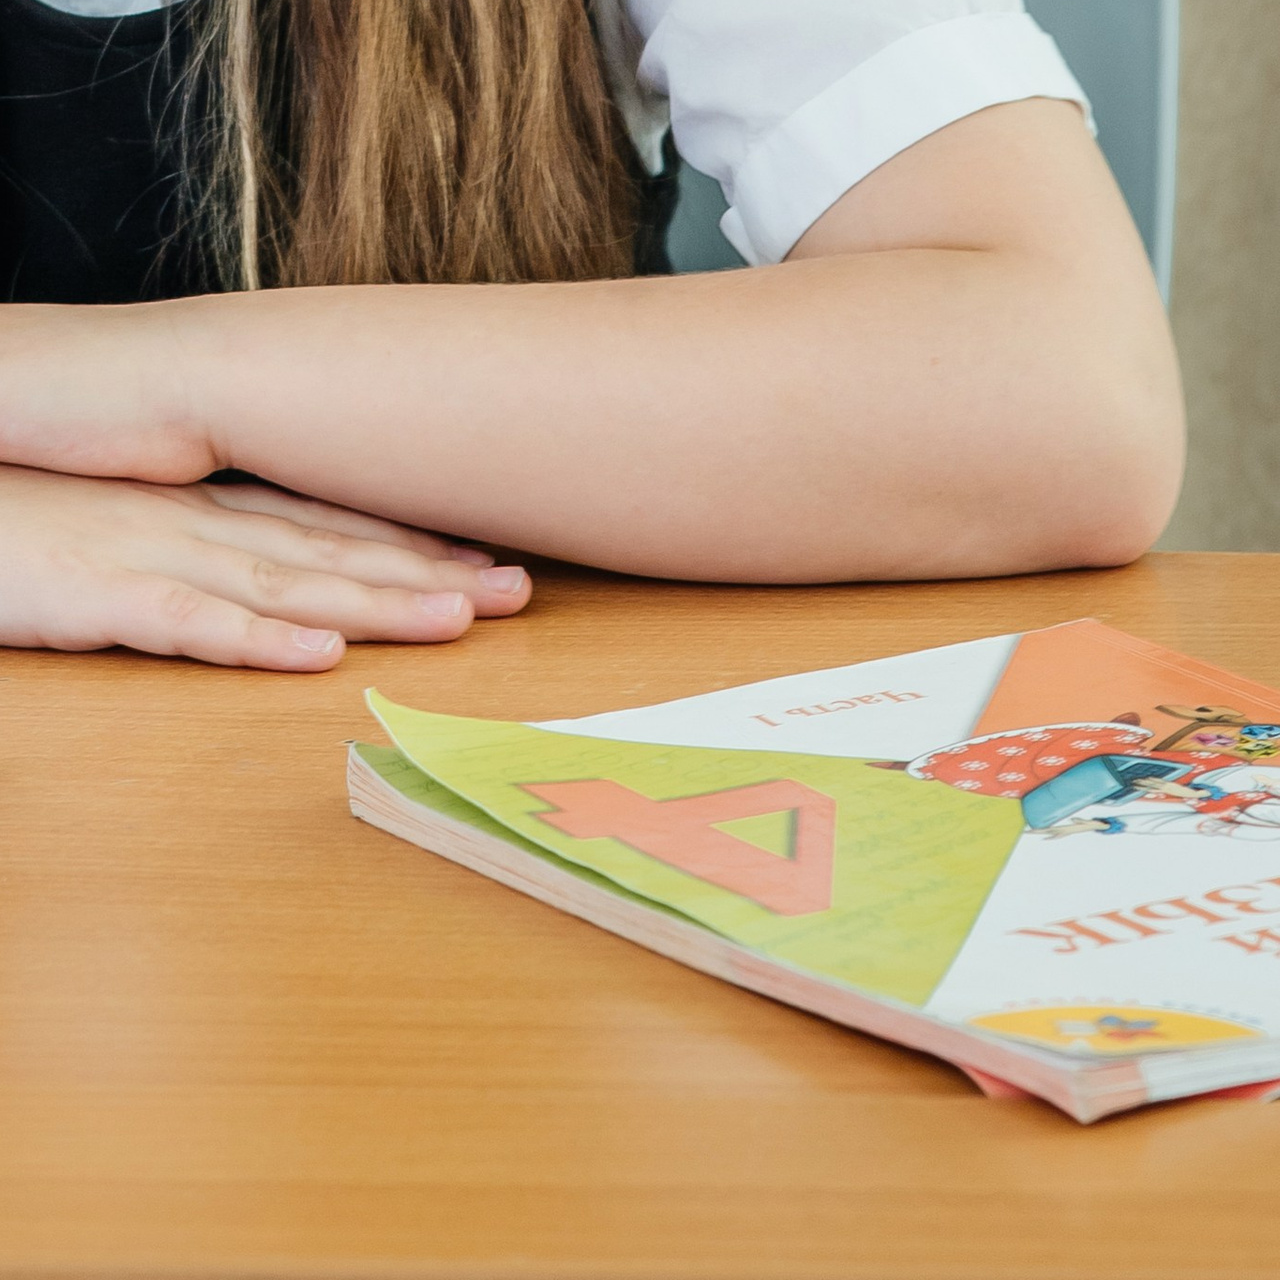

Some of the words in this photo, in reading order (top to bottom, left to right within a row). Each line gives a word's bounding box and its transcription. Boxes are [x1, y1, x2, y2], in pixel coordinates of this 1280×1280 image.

[785, 690, 928, 717] Часть
[513, 777, 837, 917] 4
[1007, 876, 1280, 955] ЗЫК
